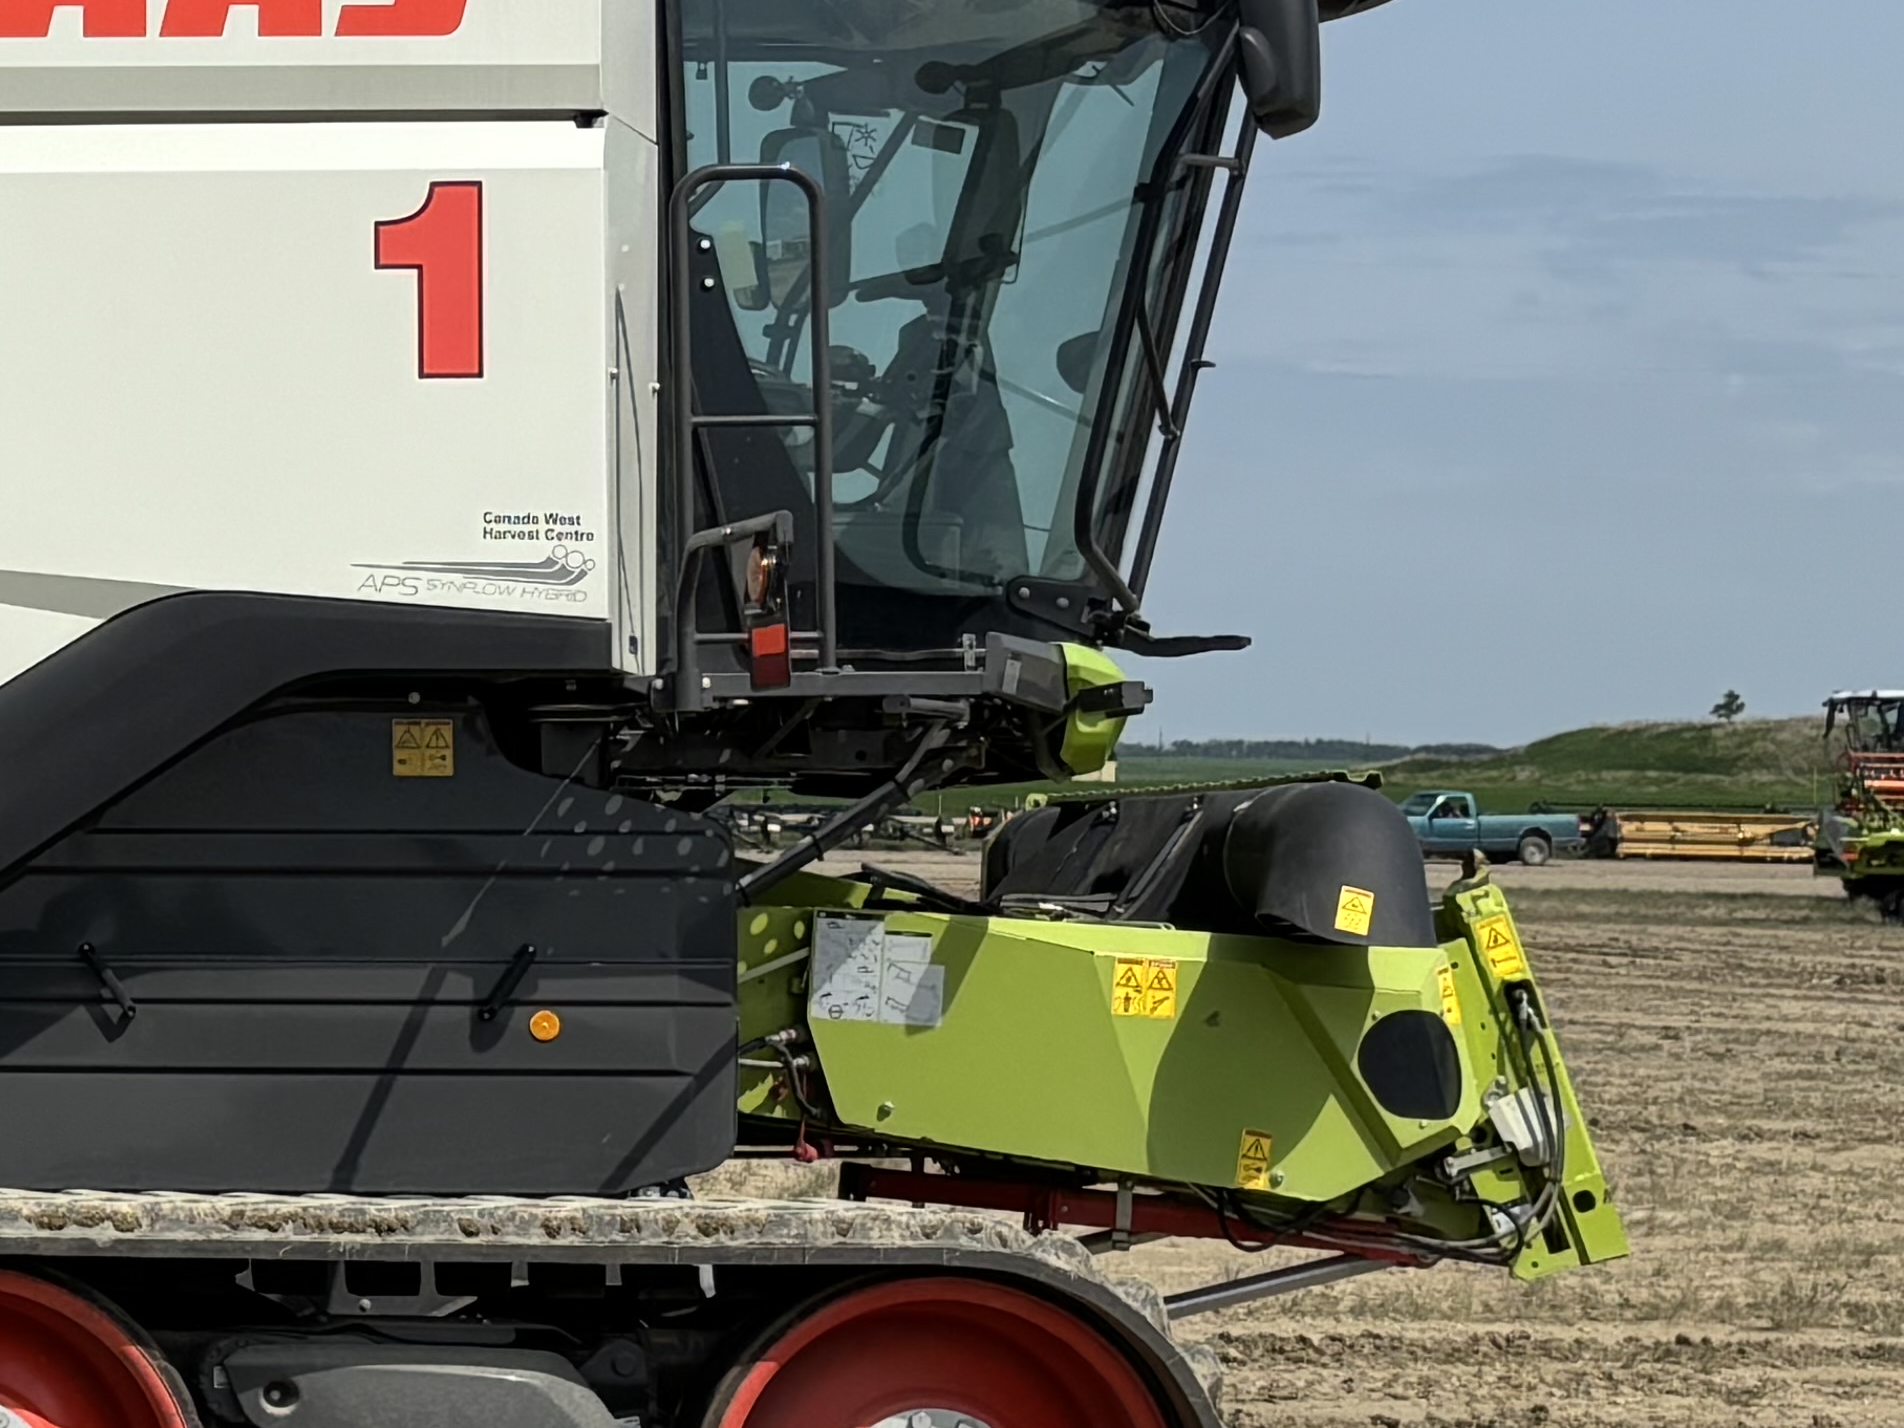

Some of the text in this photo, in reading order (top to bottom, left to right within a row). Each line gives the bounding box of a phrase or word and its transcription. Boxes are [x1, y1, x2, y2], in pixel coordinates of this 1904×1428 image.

[374, 180, 484, 378] 1
[483, 511, 581, 526] Canada West
[483, 526, 594, 542] Harvest Centre
[357, 573, 423, 597] APS
